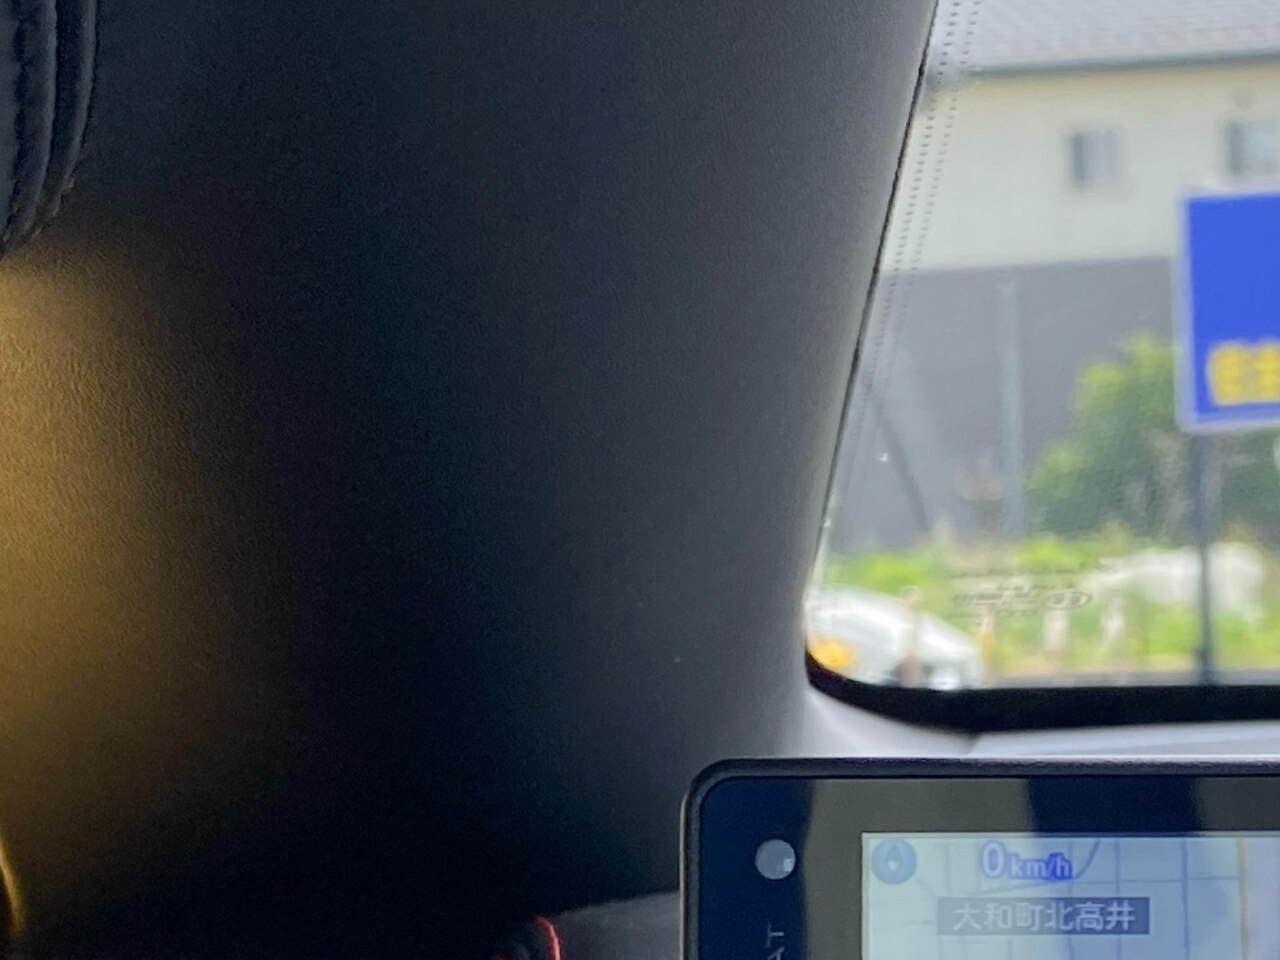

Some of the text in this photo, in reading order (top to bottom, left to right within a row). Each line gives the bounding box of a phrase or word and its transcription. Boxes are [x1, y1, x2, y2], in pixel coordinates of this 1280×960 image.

[952, 902, 1137, 932] 大和町北高井
